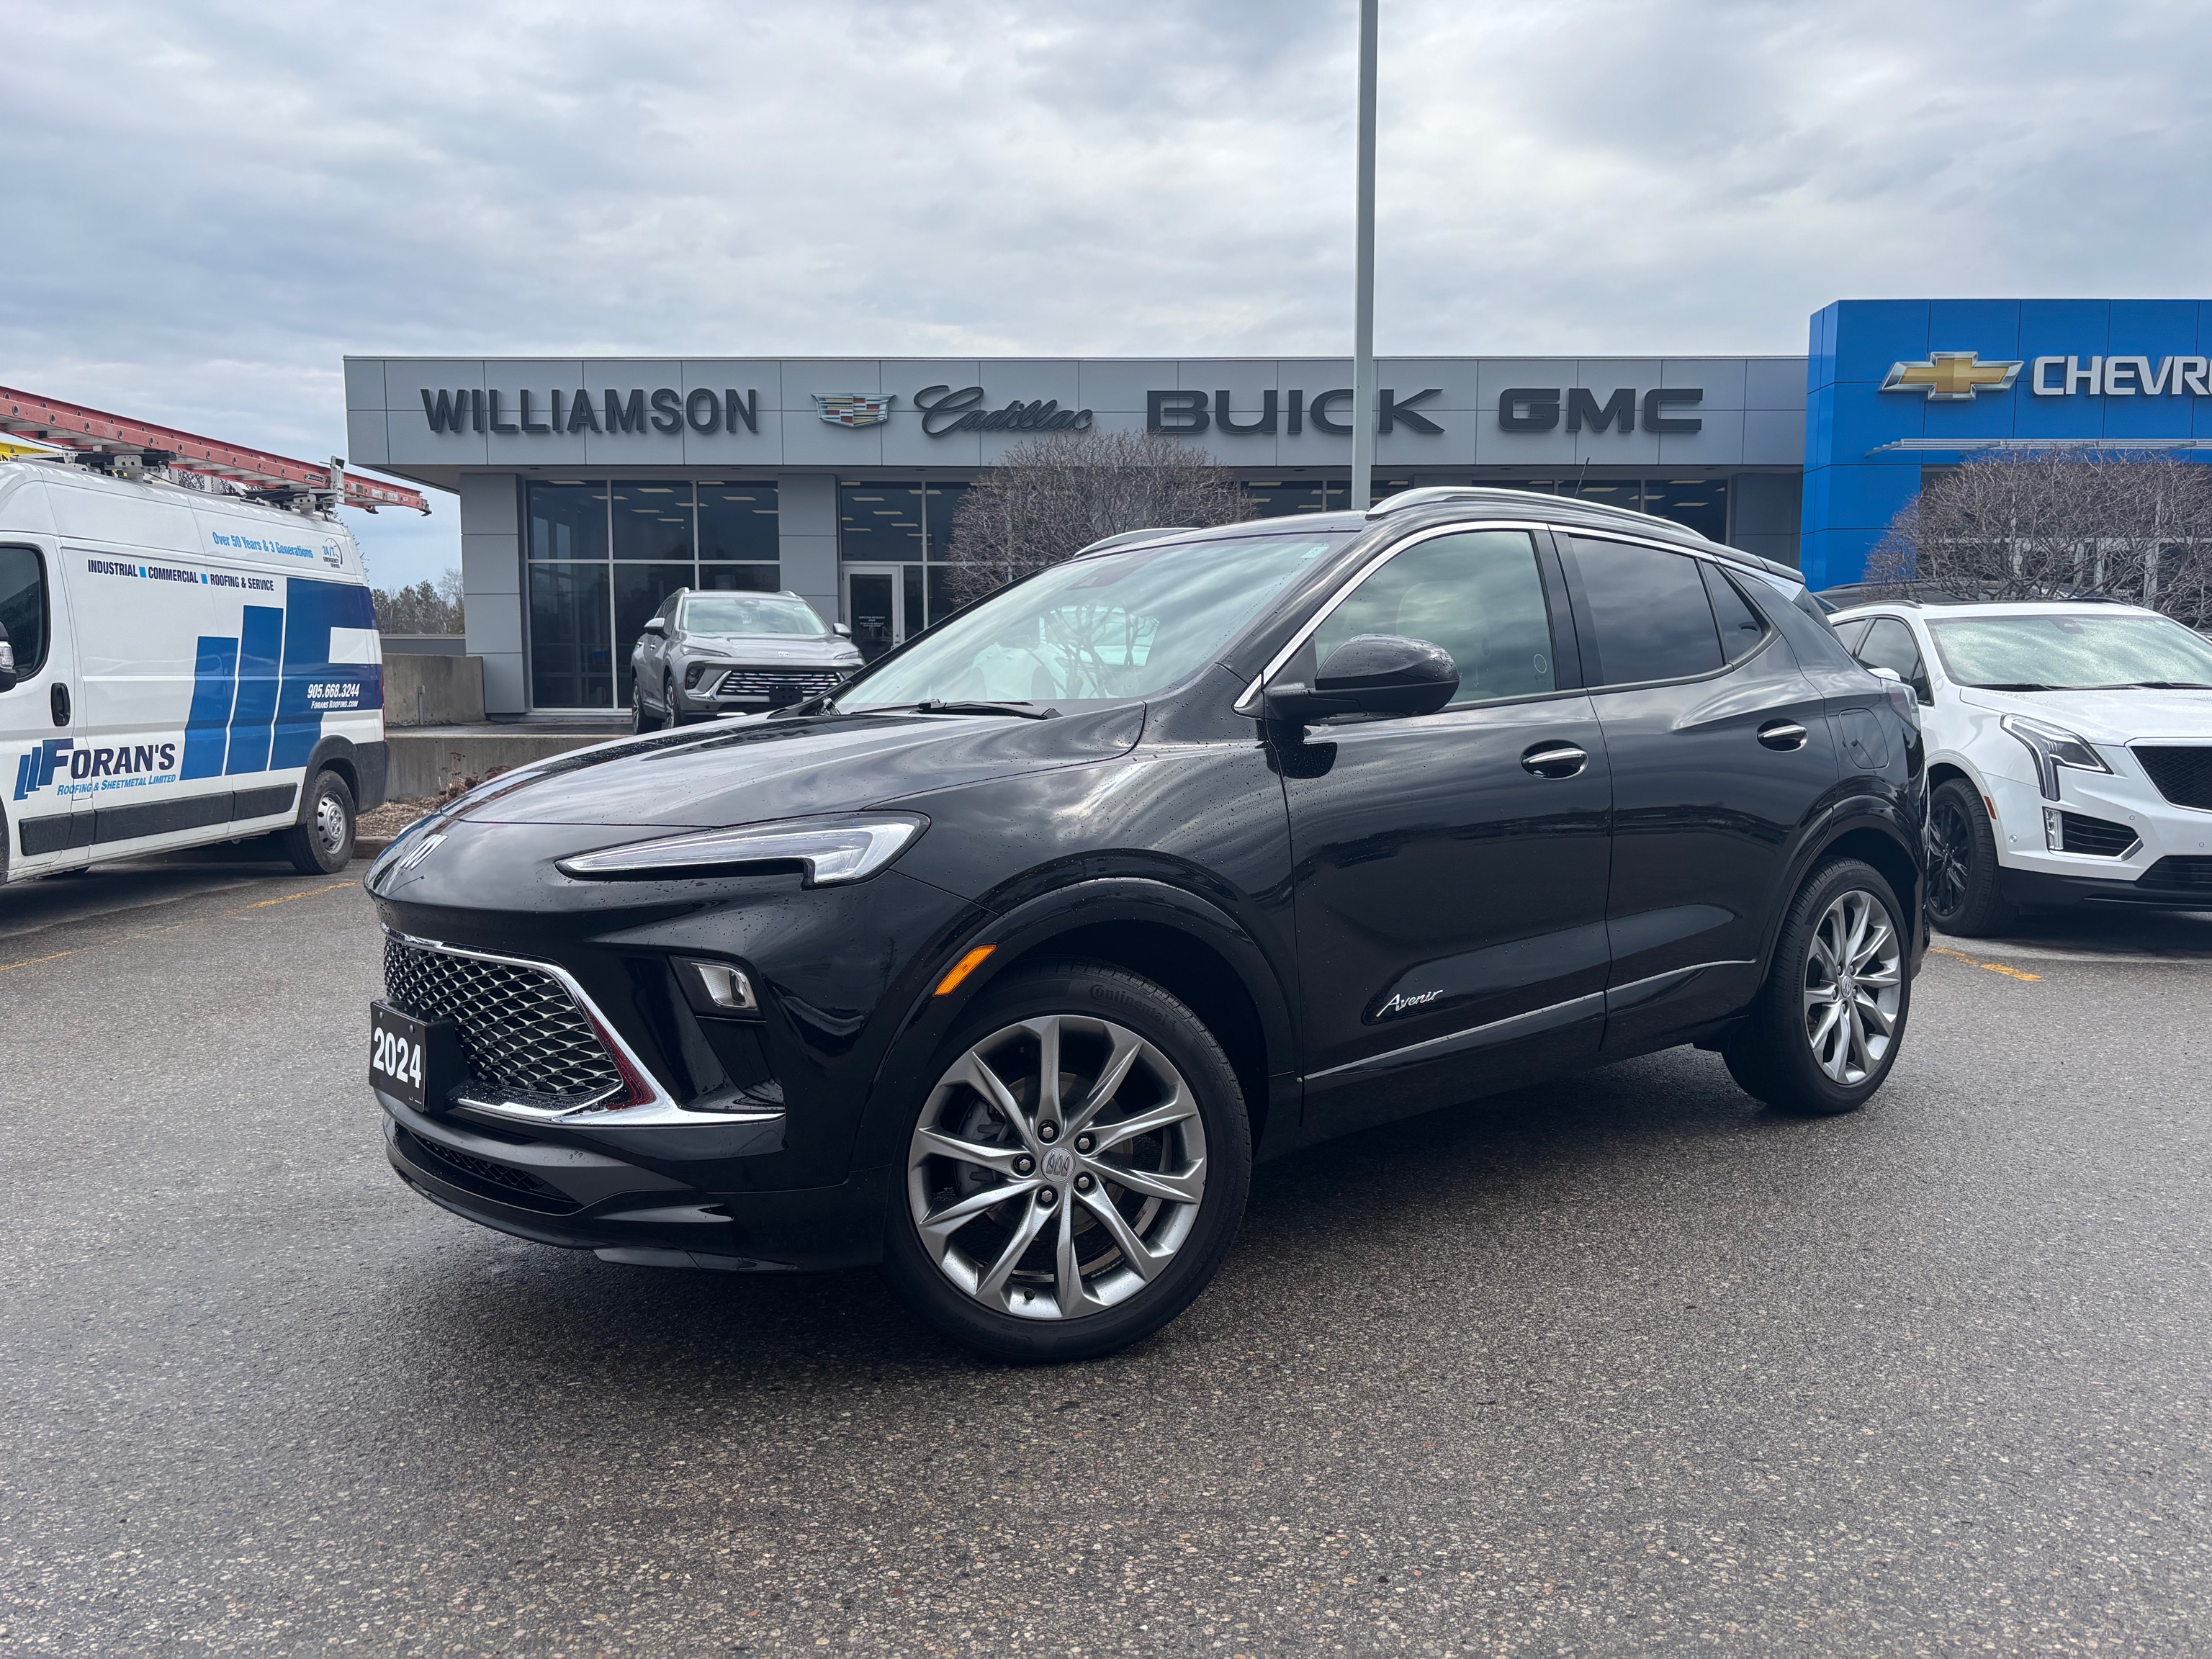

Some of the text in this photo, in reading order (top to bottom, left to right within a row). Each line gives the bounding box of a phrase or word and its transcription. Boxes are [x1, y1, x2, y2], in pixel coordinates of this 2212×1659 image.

[2033, 355, 2212, 396] CHEVR
[421, 387, 759, 433] WILLIAMSON
[914, 385, 1094, 437] Cadillac
[1146, 388, 1446, 433] BUICK
[1498, 388, 1704, 432] GMC
[212, 532, 314, 559] Over 50 Years & 3 Generations
[88, 559, 274, 591] INDUSTRIAL COMMERCIAL ROOFING & SERVICE
[307, 683, 361, 698] 905.668.3244
[37, 738, 176, 786] FORAN'S
[57, 774, 176, 796] ROOFING & SHEETMETAL LIMITED
[1089, 984, 1170, 1025] Continental
[1376, 989, 1444, 1017] Avenir
[372, 1027, 422, 1089] 2024
